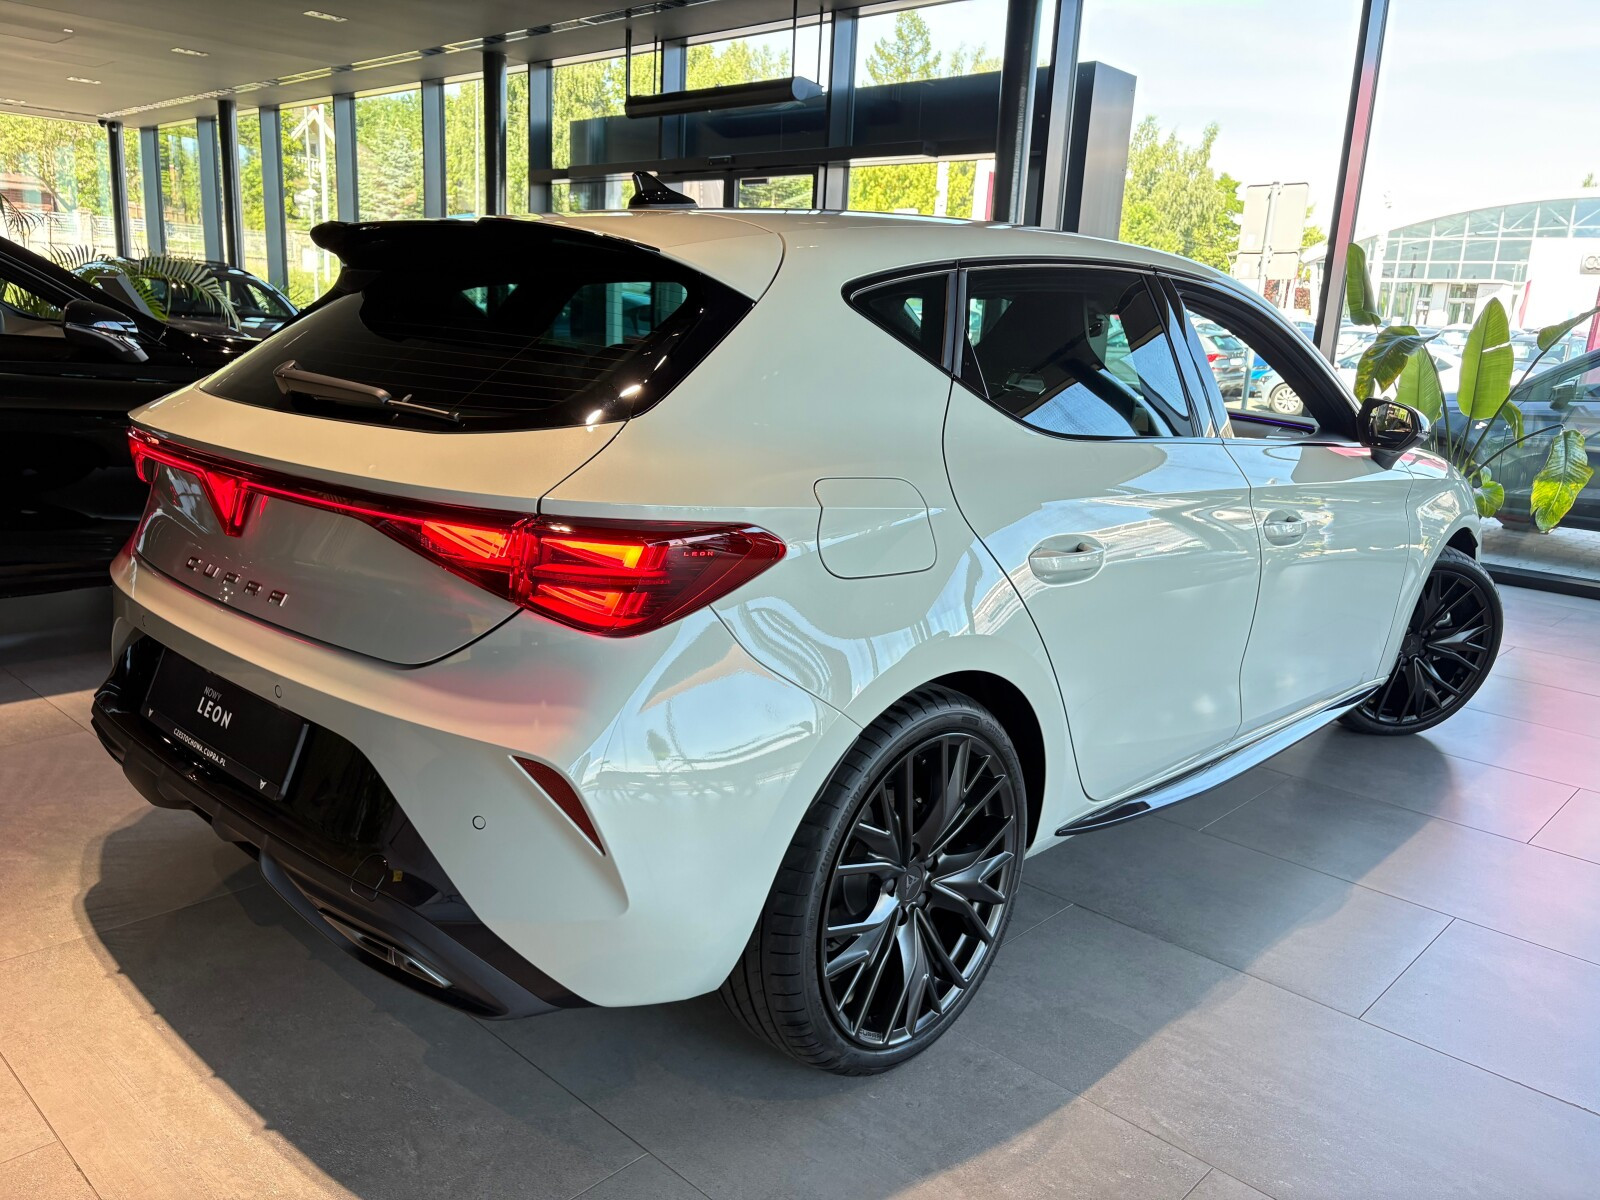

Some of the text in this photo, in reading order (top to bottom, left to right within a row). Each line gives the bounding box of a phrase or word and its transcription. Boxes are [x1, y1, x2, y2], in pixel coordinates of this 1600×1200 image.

[186, 557, 288, 607] CUPRA
[203, 686, 222, 701] NOWY
[196, 696, 233, 729] LEON
